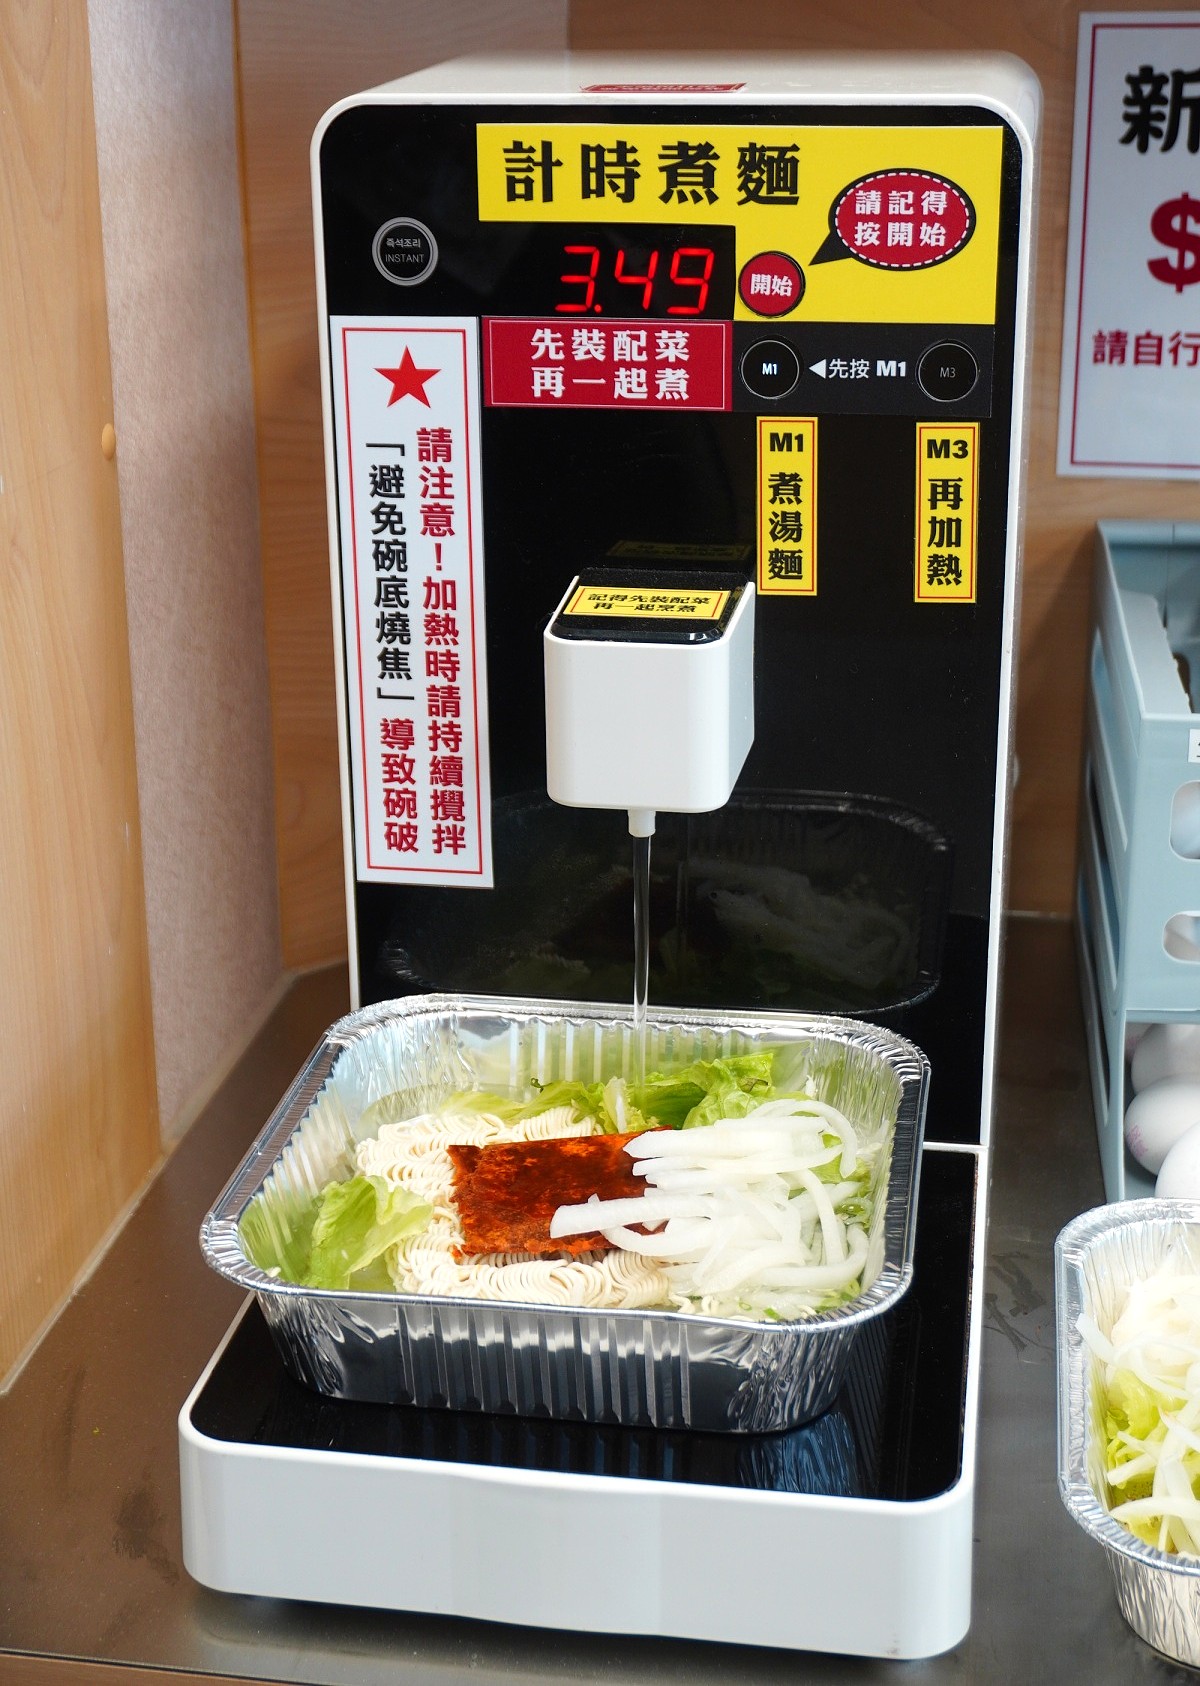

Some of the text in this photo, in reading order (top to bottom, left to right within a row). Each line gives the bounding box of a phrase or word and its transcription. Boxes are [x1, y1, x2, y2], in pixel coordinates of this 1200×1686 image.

[1119, 65, 1200, 154] 新
[503, 140, 801, 206] 計時煮麵
[855, 190, 948, 216] 請記得
[386, 238, 421, 248] 즉석조리
[854, 221, 947, 247] 按開始
[385, 253, 425, 263] INSTANT
[555, 245, 714, 315] 3.49
[750, 273, 793, 297] 開始
[530, 329, 690, 363] 先裝配菜
[1092, 329, 1200, 367] 請自行
[762, 363, 778, 376] M1
[829, 358, 907, 379] 先按 M1
[939, 366, 956, 378] M3
[531, 366, 690, 401] 再一起煮
[769, 432, 805, 452] M1
[926, 438, 969, 460] M3
[768, 472, 803, 581] 煮湯麵
[927, 477, 963, 587] 再加熱
[587, 593, 711, 605] 記得先裝配菜
